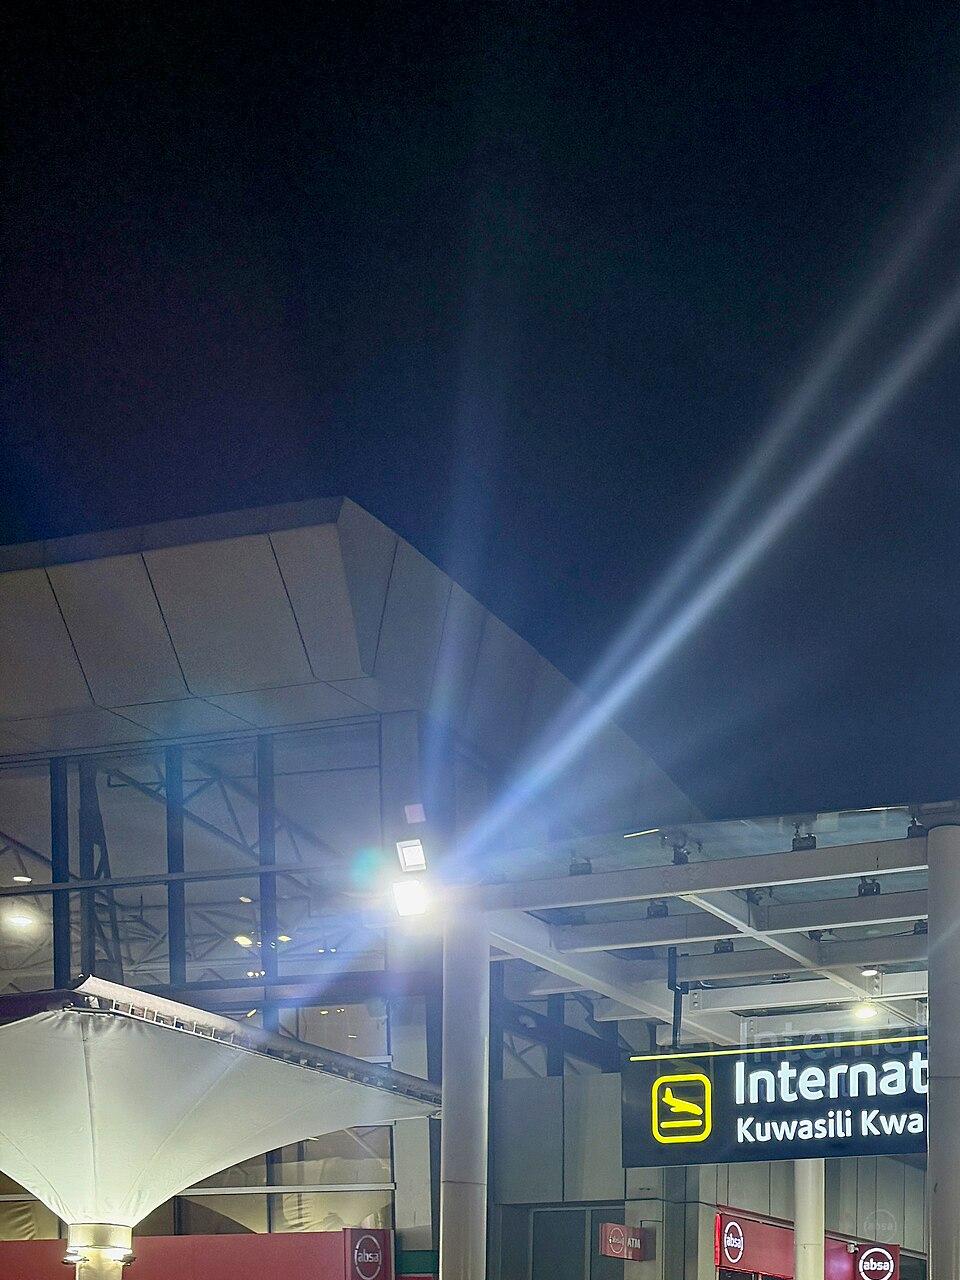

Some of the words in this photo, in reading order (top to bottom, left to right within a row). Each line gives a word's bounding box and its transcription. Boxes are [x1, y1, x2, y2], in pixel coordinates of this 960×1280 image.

[737, 1109, 852, 1143] Kuwasili
[861, 1109, 924, 1136] Kwa
[627, 1237, 641, 1249] ATM
[726, 1233, 742, 1248] absa
[357, 1250, 379, 1263] absa
[863, 1257, 890, 1271] absa
